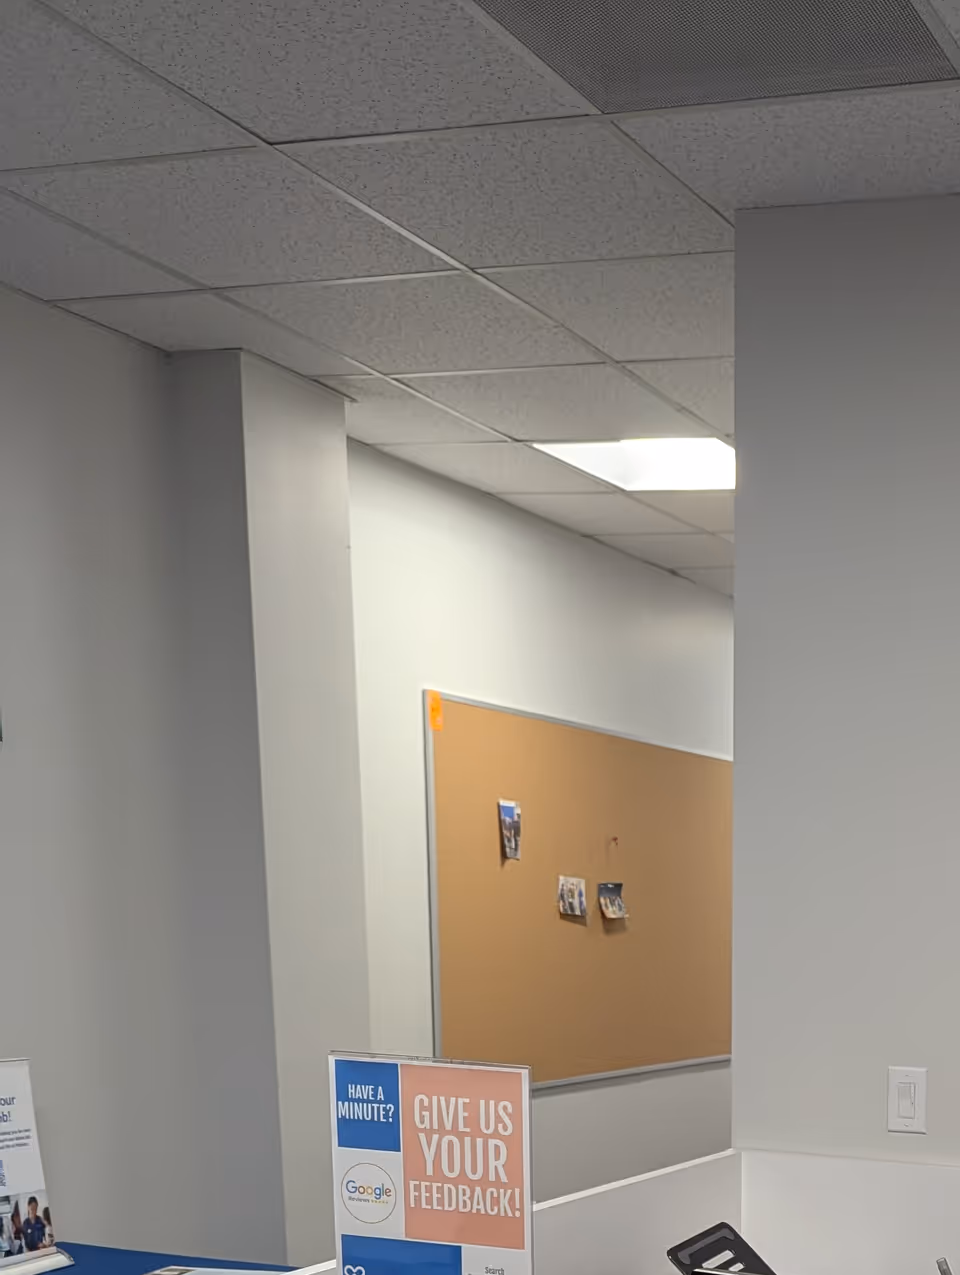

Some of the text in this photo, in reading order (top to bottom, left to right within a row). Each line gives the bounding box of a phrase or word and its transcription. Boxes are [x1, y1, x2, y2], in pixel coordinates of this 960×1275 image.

[348, 1084, 384, 1101] HAVE A
[338, 1101, 394, 1122] MINUTE?
[413, 1094, 513, 1136] GIVE US
[418, 1133, 508, 1183] YOUR
[345, 1180, 392, 1200] Google
[409, 1180, 521, 1218] FEEDBACK!
[484, 1266, 505, 1275] Search
